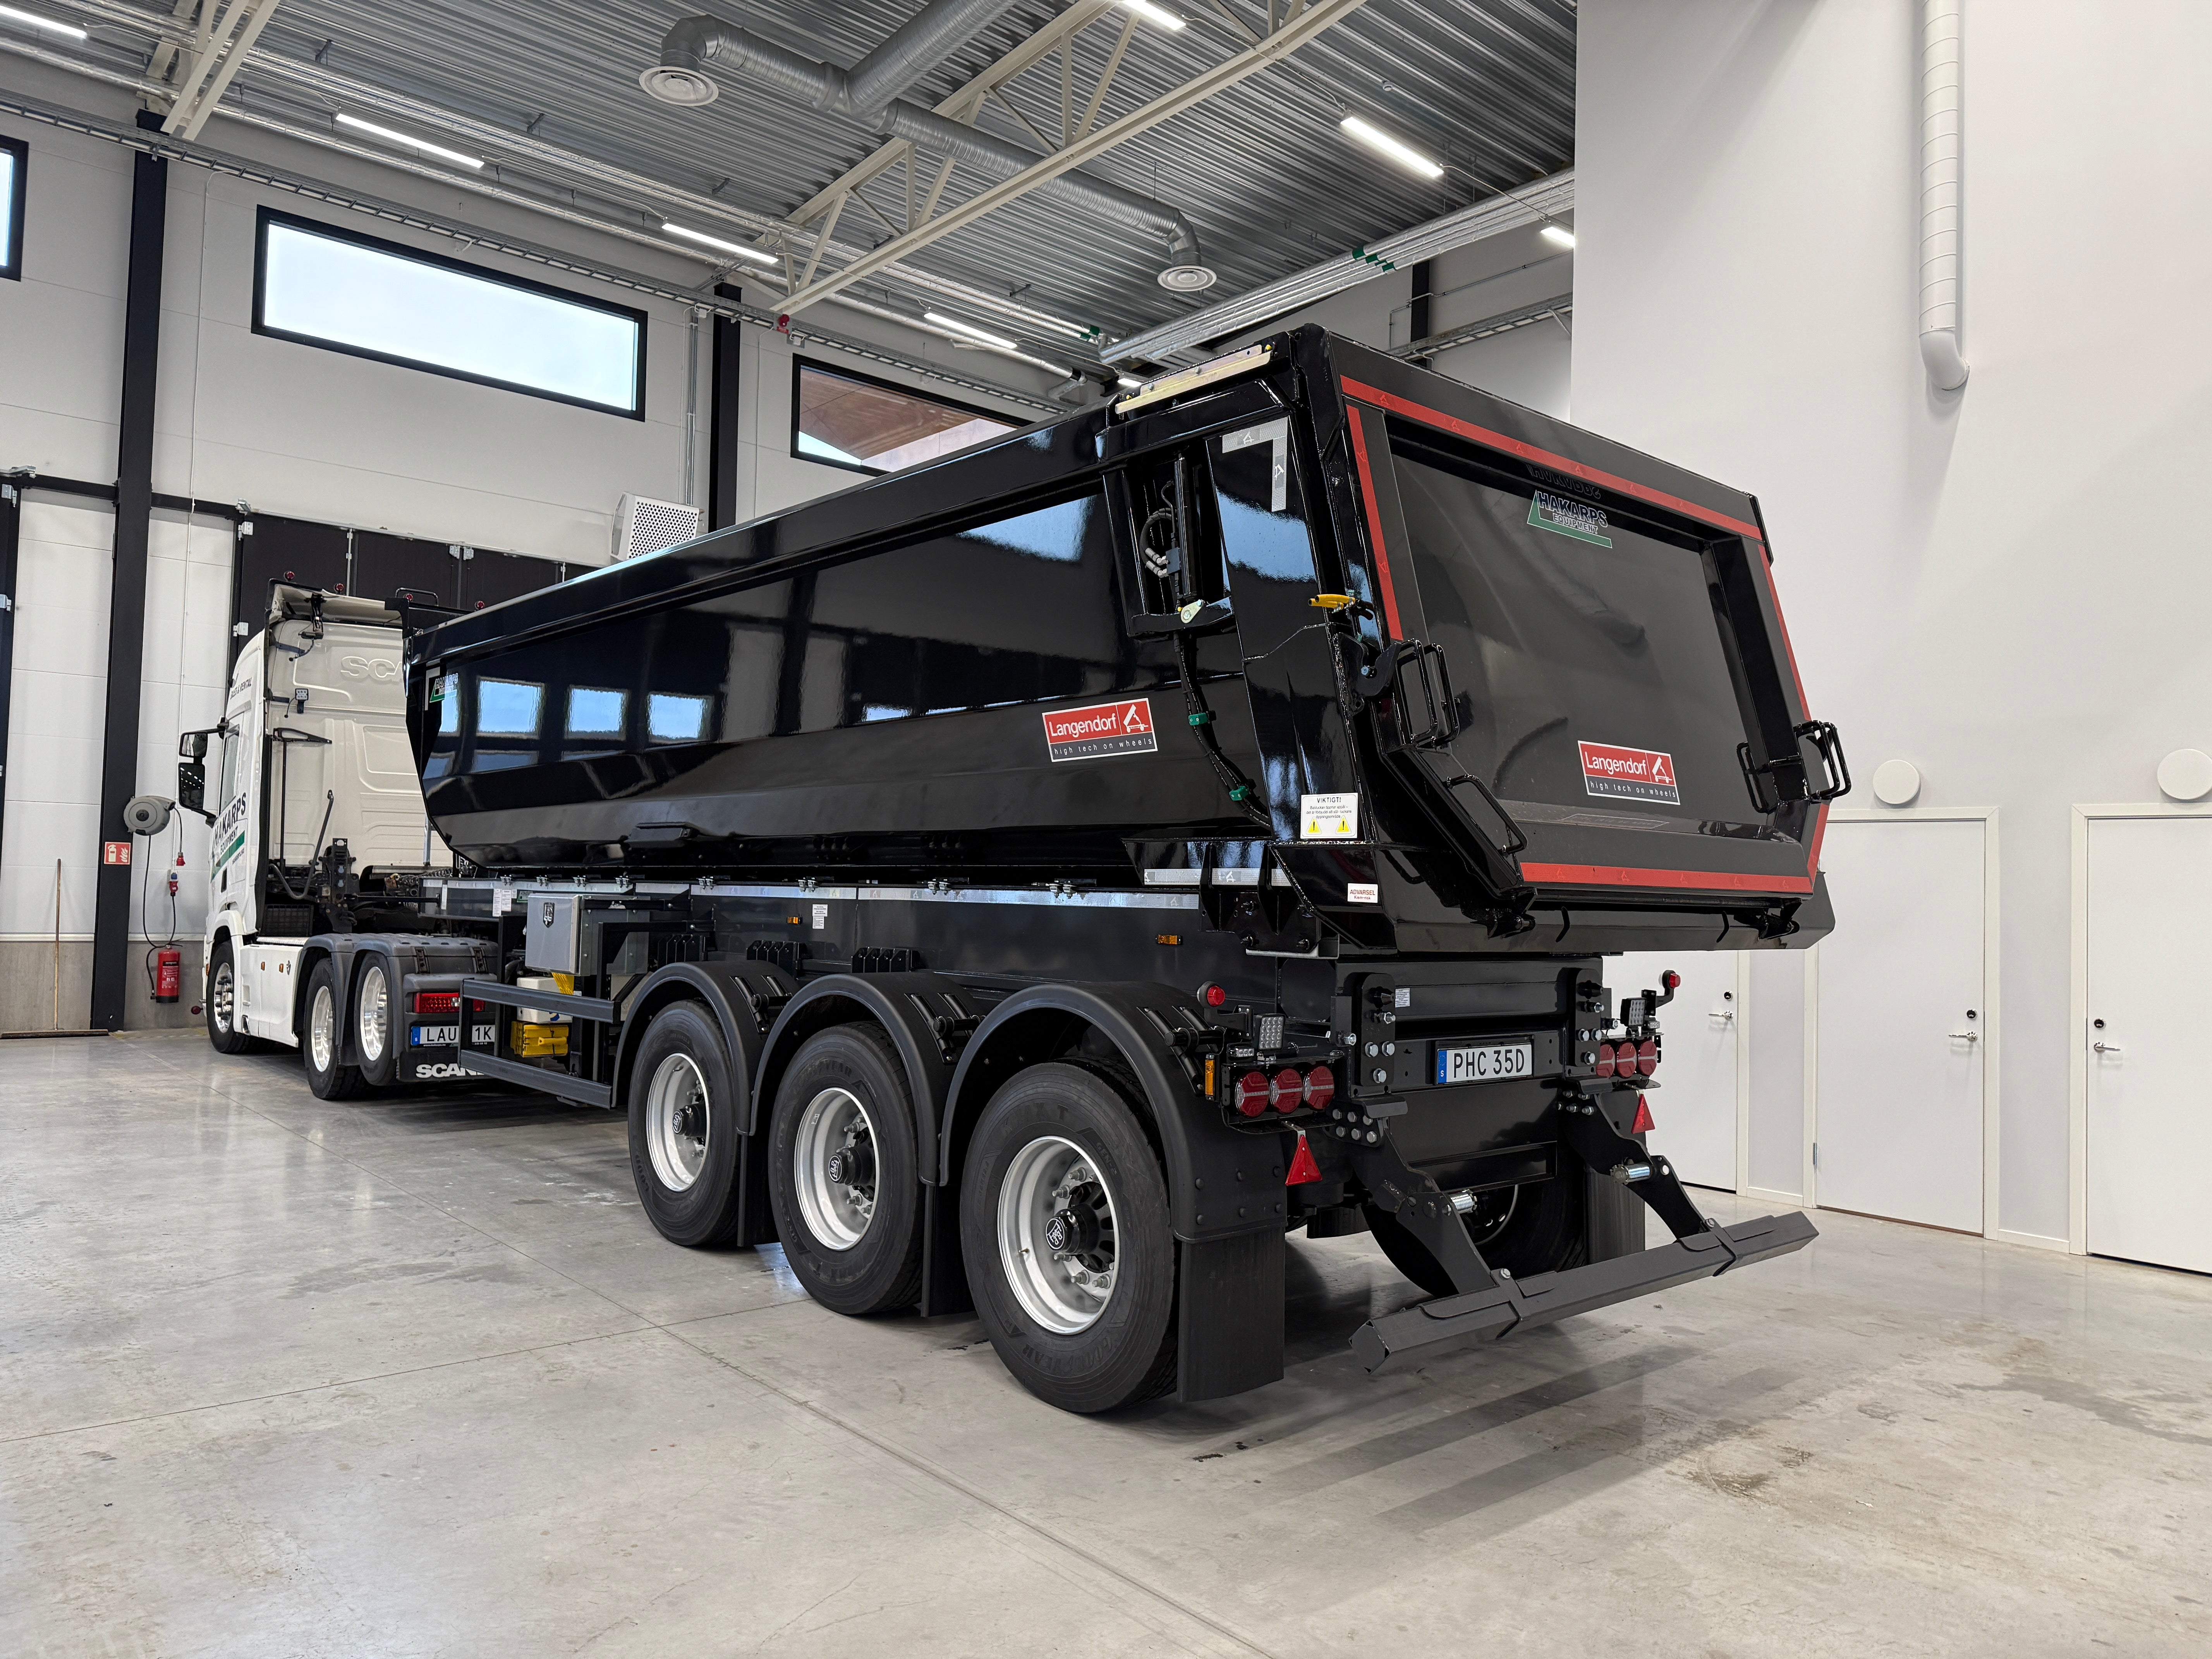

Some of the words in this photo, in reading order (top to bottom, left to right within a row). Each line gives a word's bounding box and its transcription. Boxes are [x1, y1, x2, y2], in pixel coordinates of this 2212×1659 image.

[1537, 491, 1607, 527] HAKARPS
[1553, 513, 1598, 534] EQUIPMENT
[1049, 713, 1116, 738] Langendorf
[1054, 747, 1073, 756] high
[1119, 738, 1152, 748] wheels
[1585, 751, 1647, 775] Langendorf
[1590, 781, 1608, 790] high
[1614, 782, 1631, 792] tech
[1649, 788, 1675, 797] wheels
[214, 792, 246, 849] HAKARPS
[221, 826, 238, 855] EQUIPMENT
[427, 1027, 457, 1042] LAU
[475, 1027, 491, 1041] 1K
[1454, 1051, 1486, 1078] PHC
[1493, 1048, 1524, 1075] 35D
